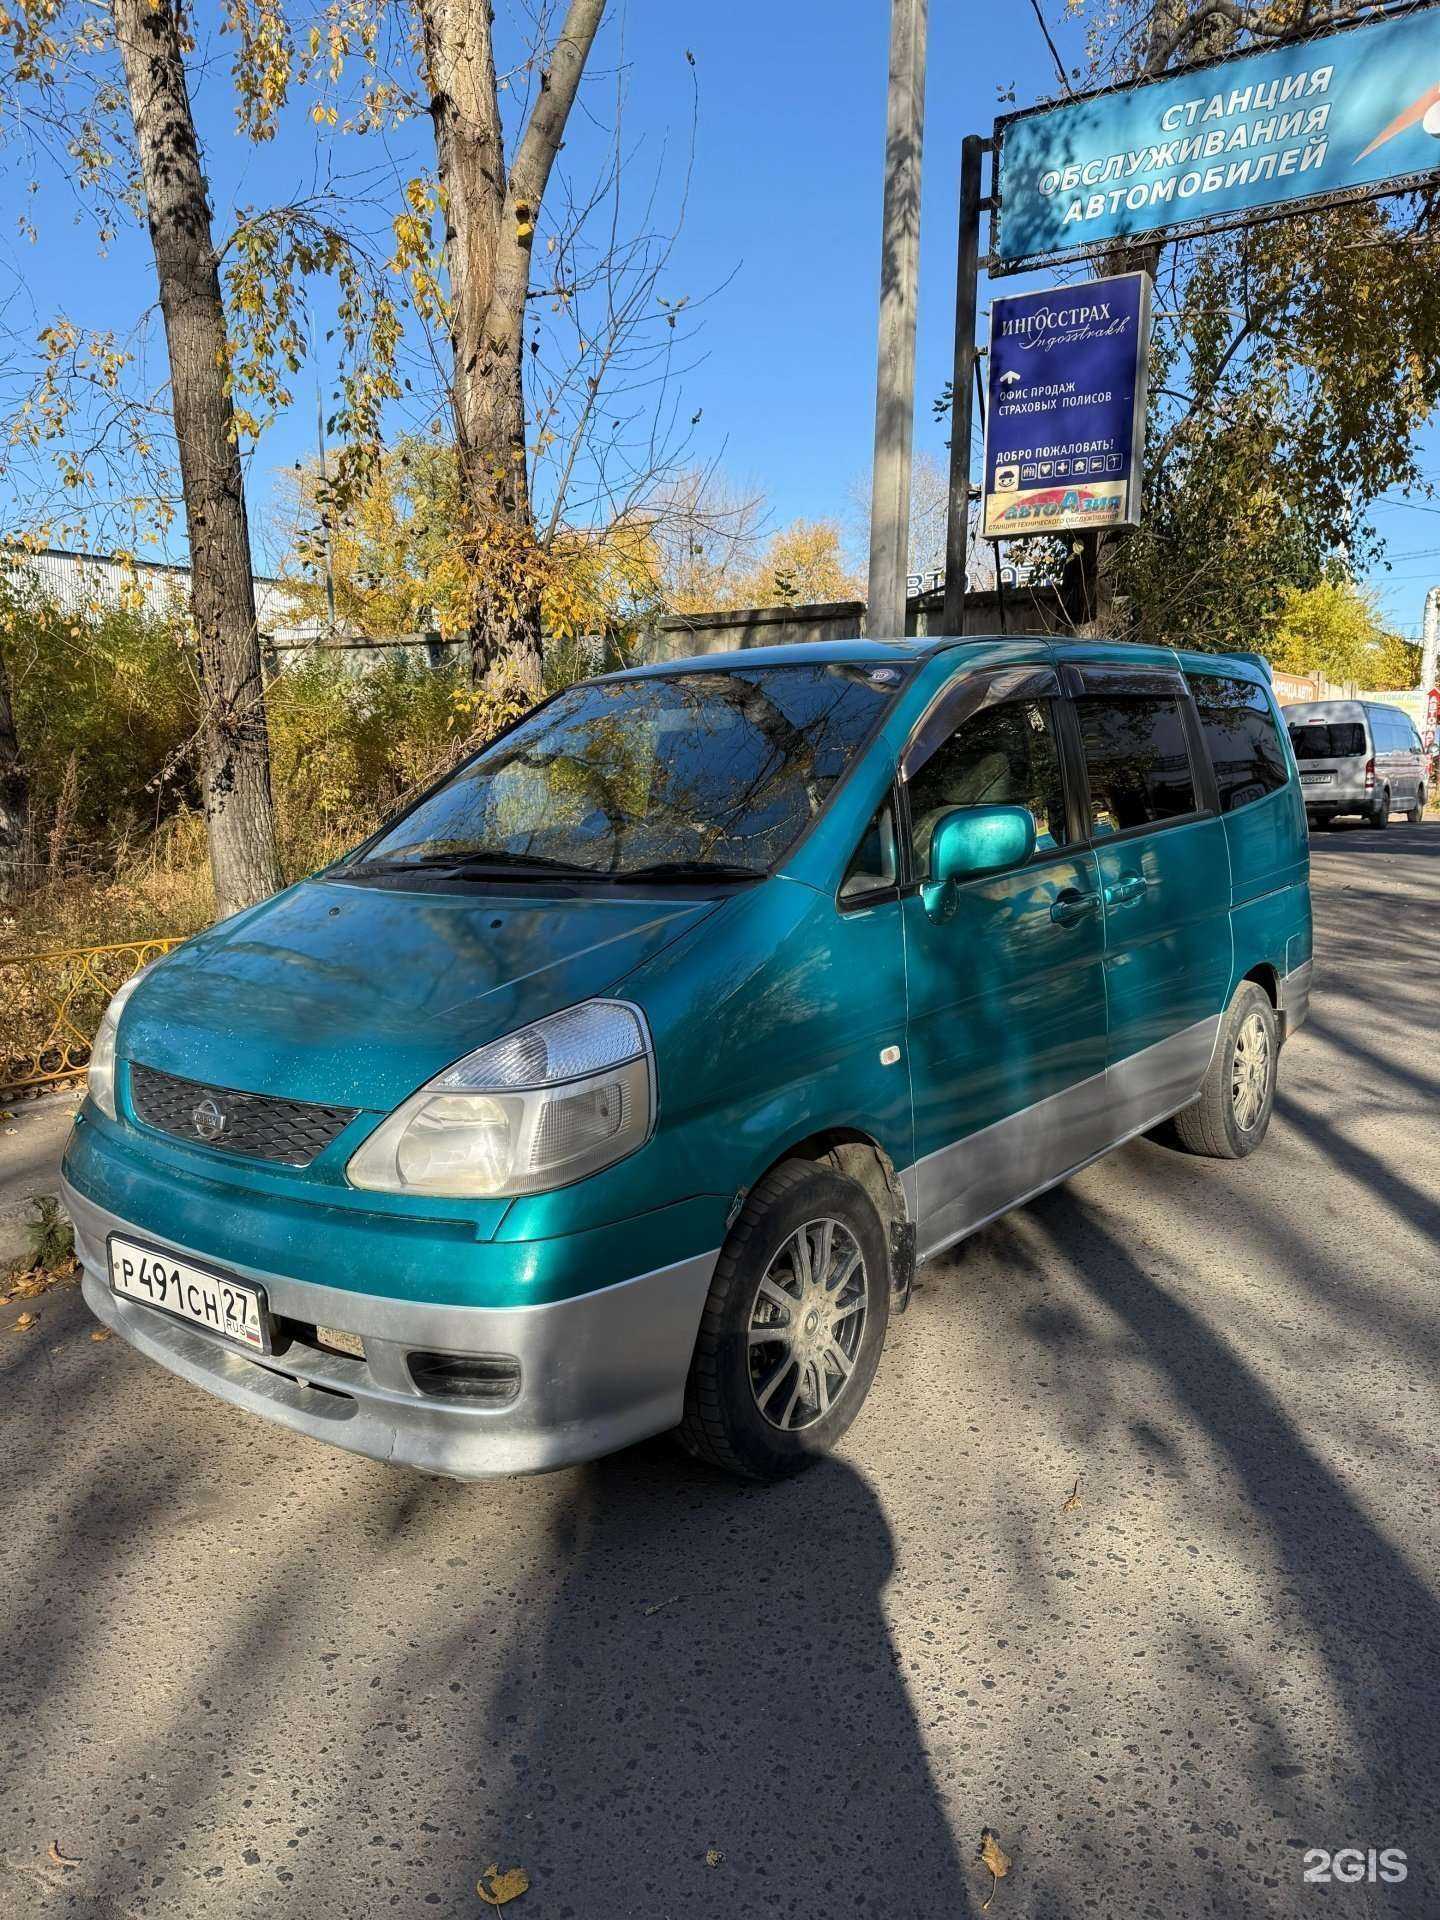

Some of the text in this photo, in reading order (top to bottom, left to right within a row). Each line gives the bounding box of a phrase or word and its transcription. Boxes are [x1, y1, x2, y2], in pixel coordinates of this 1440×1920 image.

[1160, 65, 1335, 132] СТАНЦИЯ
[1038, 104, 1332, 197] ОБСЛУЖИВАНИЯ
[1062, 137, 1330, 225] АВТОМОБИЛЕЙ
[1002, 303, 1111, 336] ИНГОССТРАХ
[1018, 307, 1130, 352] Ingosstrakh
[999, 392, 1112, 416] СТРАХОВЫХ ПОЛИСОВ
[1000, 382, 1075, 401] ОФИС ПРОДАЖ
[996, 439, 1114, 464] ДОБРО ПОЖАЛОВАТЬ!
[226, 1320, 245, 1336] RUS
